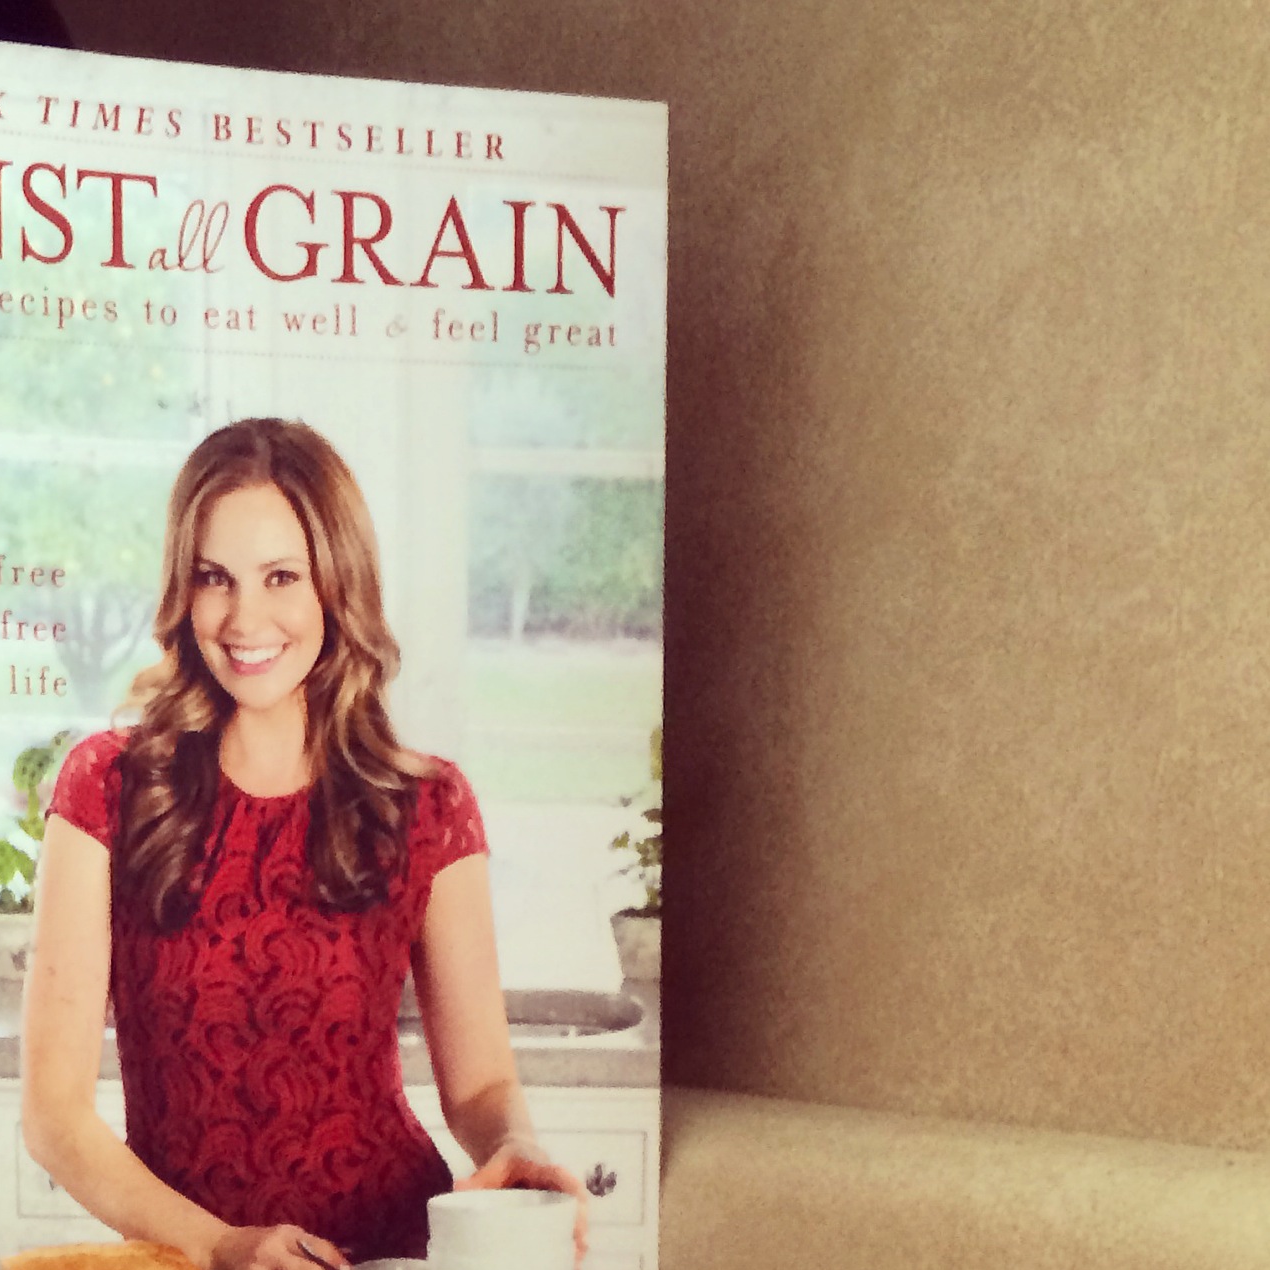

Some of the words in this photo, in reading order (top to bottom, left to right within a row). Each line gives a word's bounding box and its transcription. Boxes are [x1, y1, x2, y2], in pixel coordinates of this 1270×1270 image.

[38, 95, 183, 139] TIMES
[213, 113, 506, 160] BESTSELLER
[148, 199, 230, 273] all
[243, 183, 627, 298] GRAIN
[144, 301, 178, 327] to
[204, 306, 257, 332] eat
[284, 305, 358, 337] well
[385, 314, 408, 337] &
[432, 308, 499, 343] feel
[524, 319, 617, 354] great
[10, 664, 68, 697] life
